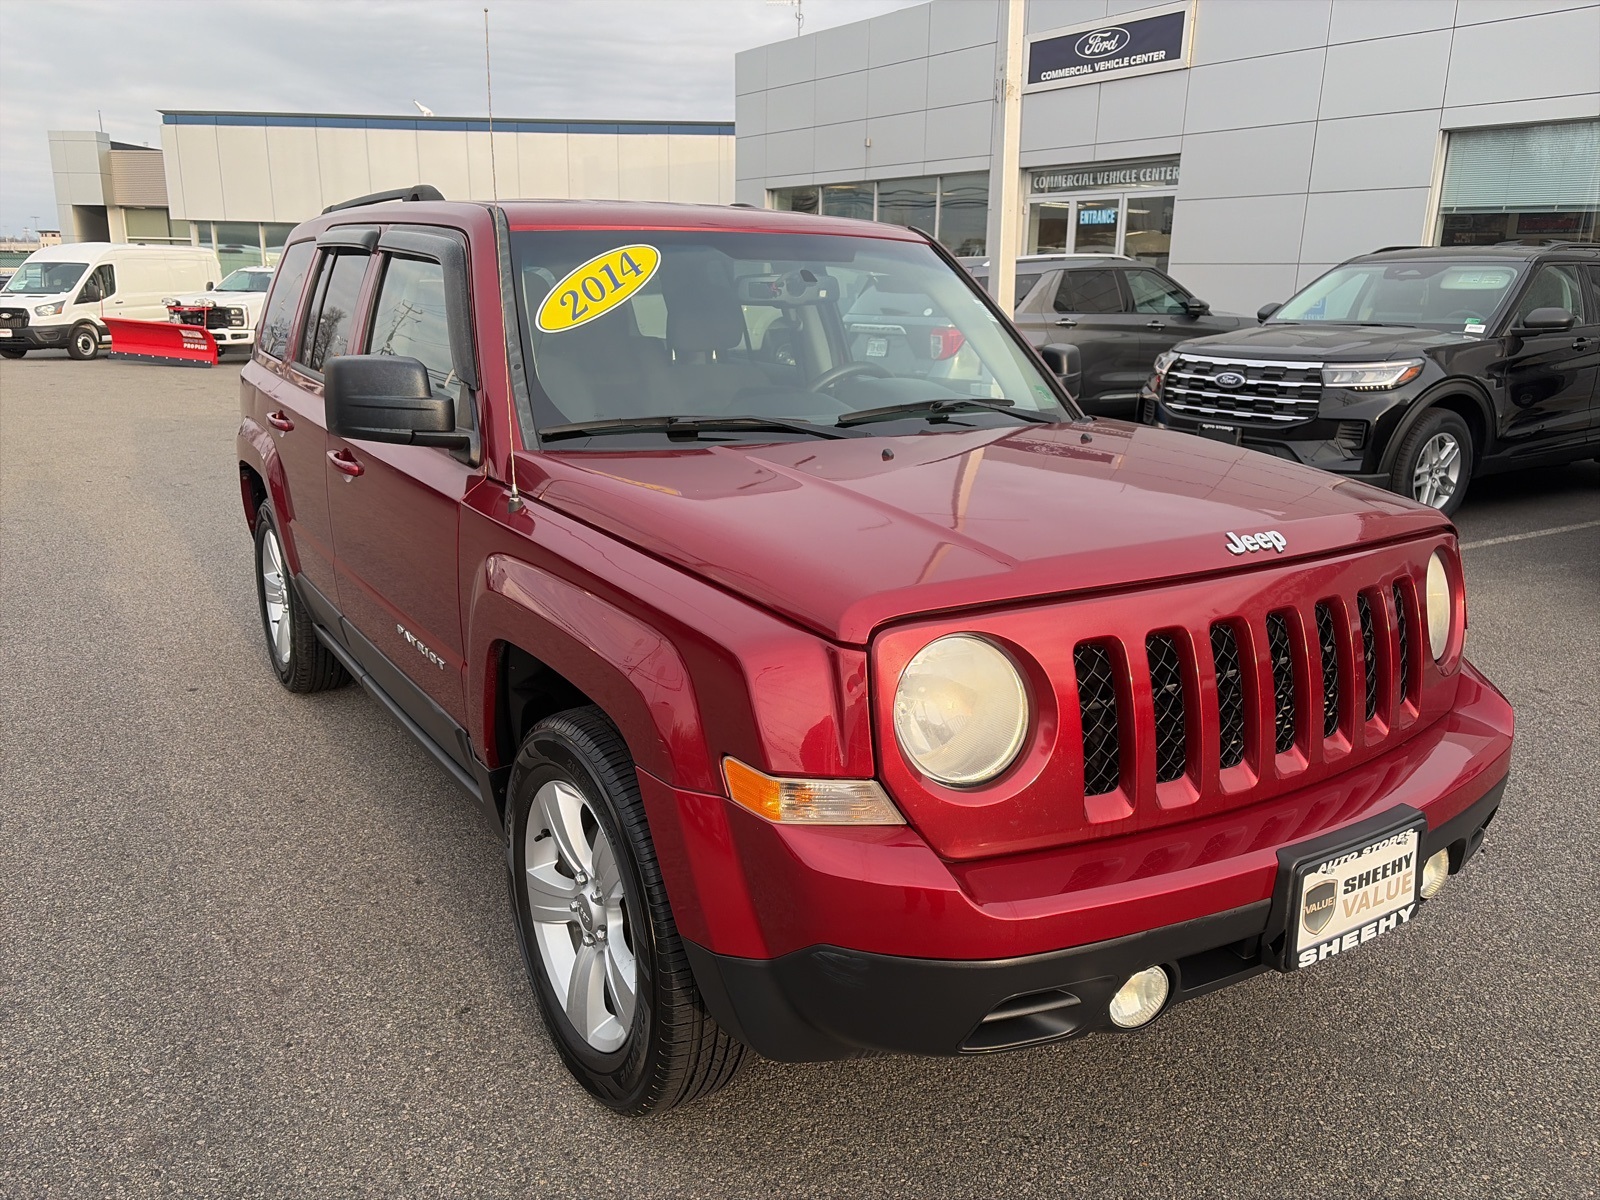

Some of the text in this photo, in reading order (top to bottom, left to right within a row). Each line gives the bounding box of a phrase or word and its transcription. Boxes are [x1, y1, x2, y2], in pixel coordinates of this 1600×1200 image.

[1084, 31, 1119, 55] Ford
[1041, 50, 1166, 81] COMMERCIAL VEHICLE CENTER
[1033, 166, 1180, 189] COMMERCIAL VEHICLE CENTER
[1079, 209, 1116, 225] ENTRANCE
[560, 251, 644, 321] 2014
[1225, 530, 1287, 555] Jeep
[397, 624, 446, 670] PATRIOT
[1316, 828, 1415, 875] AUTO STORES
[1343, 851, 1414, 895] SHEEHY
[1304, 896, 1335, 915] VALUE
[1342, 870, 1413, 919] VALUE
[1298, 903, 1416, 968] SHEEHY
